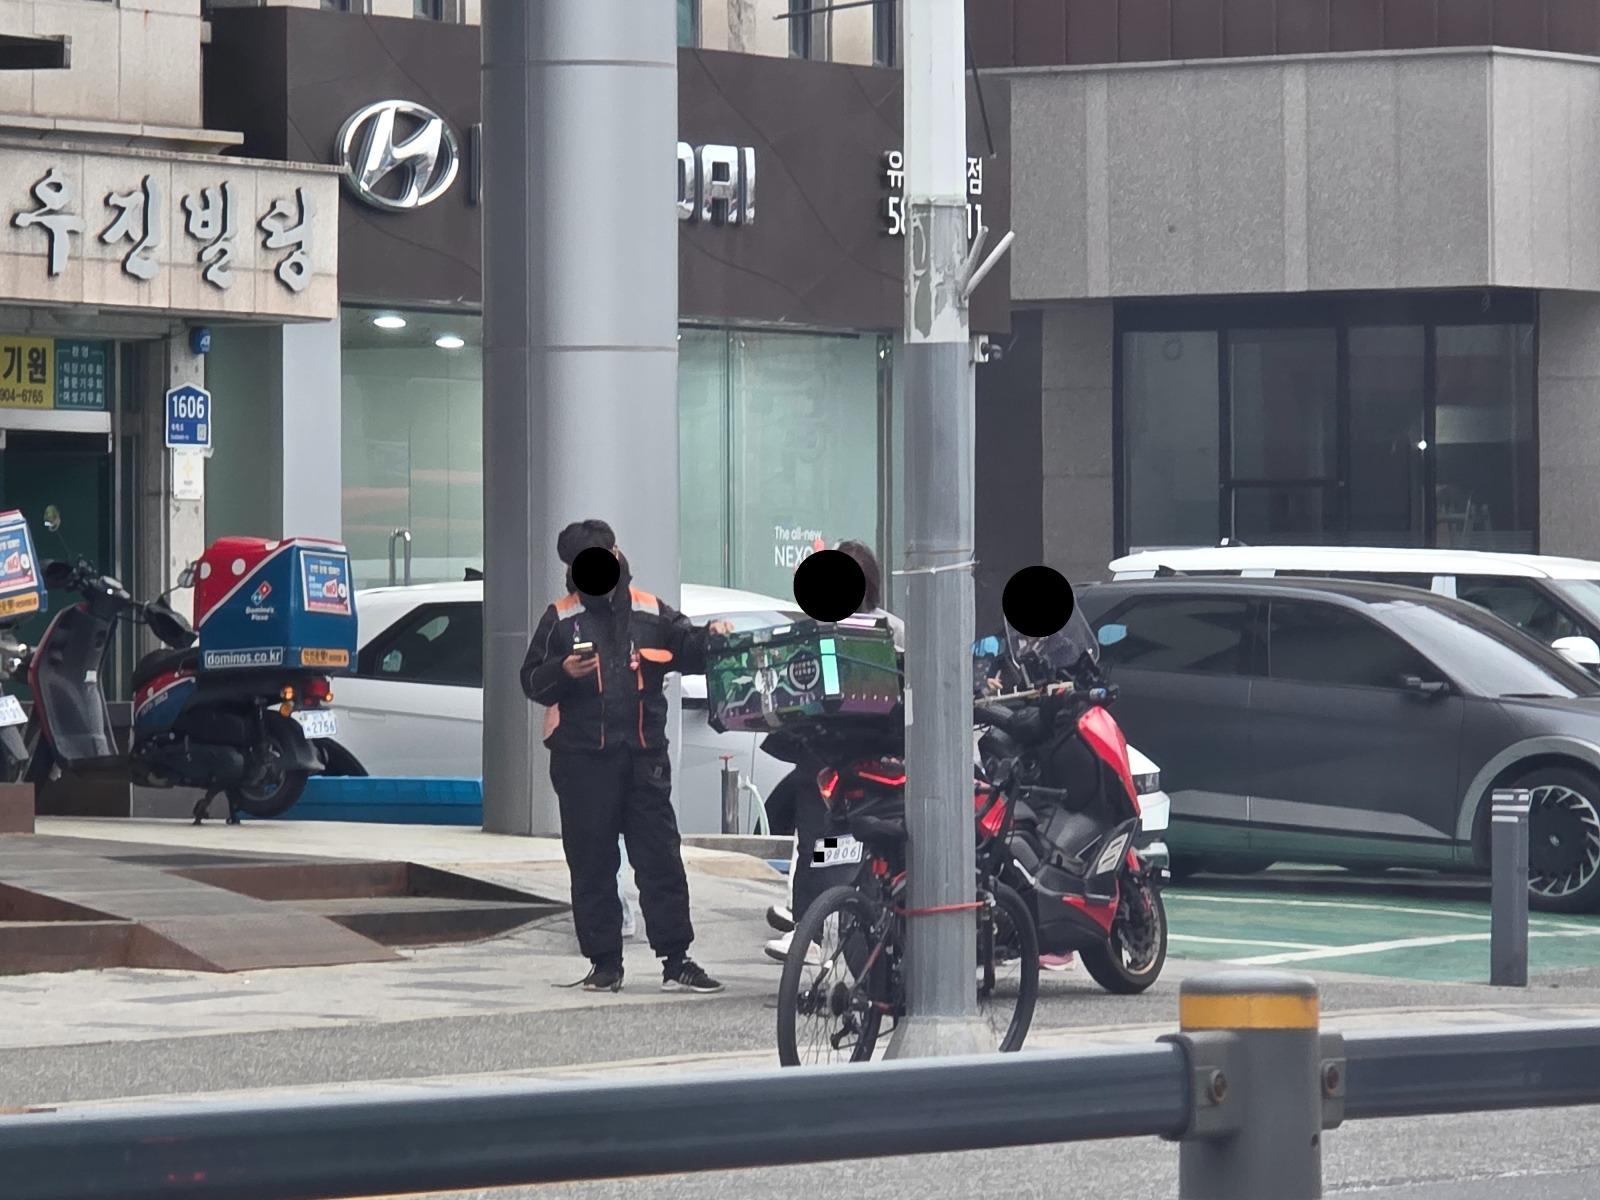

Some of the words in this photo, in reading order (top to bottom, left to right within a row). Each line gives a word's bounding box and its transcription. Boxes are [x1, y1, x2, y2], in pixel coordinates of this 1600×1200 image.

[967, 157, 982, 195] 점
[11, 168, 314, 293] 우진빌딩
[888, 197, 905, 235] 5
[3, 346, 46, 384] 기원
[172, 395, 205, 419] 1606
[774, 525, 790, 541] The
[791, 526, 822, 542] all-new
[207, 651, 281, 665] dominos.co.kr
